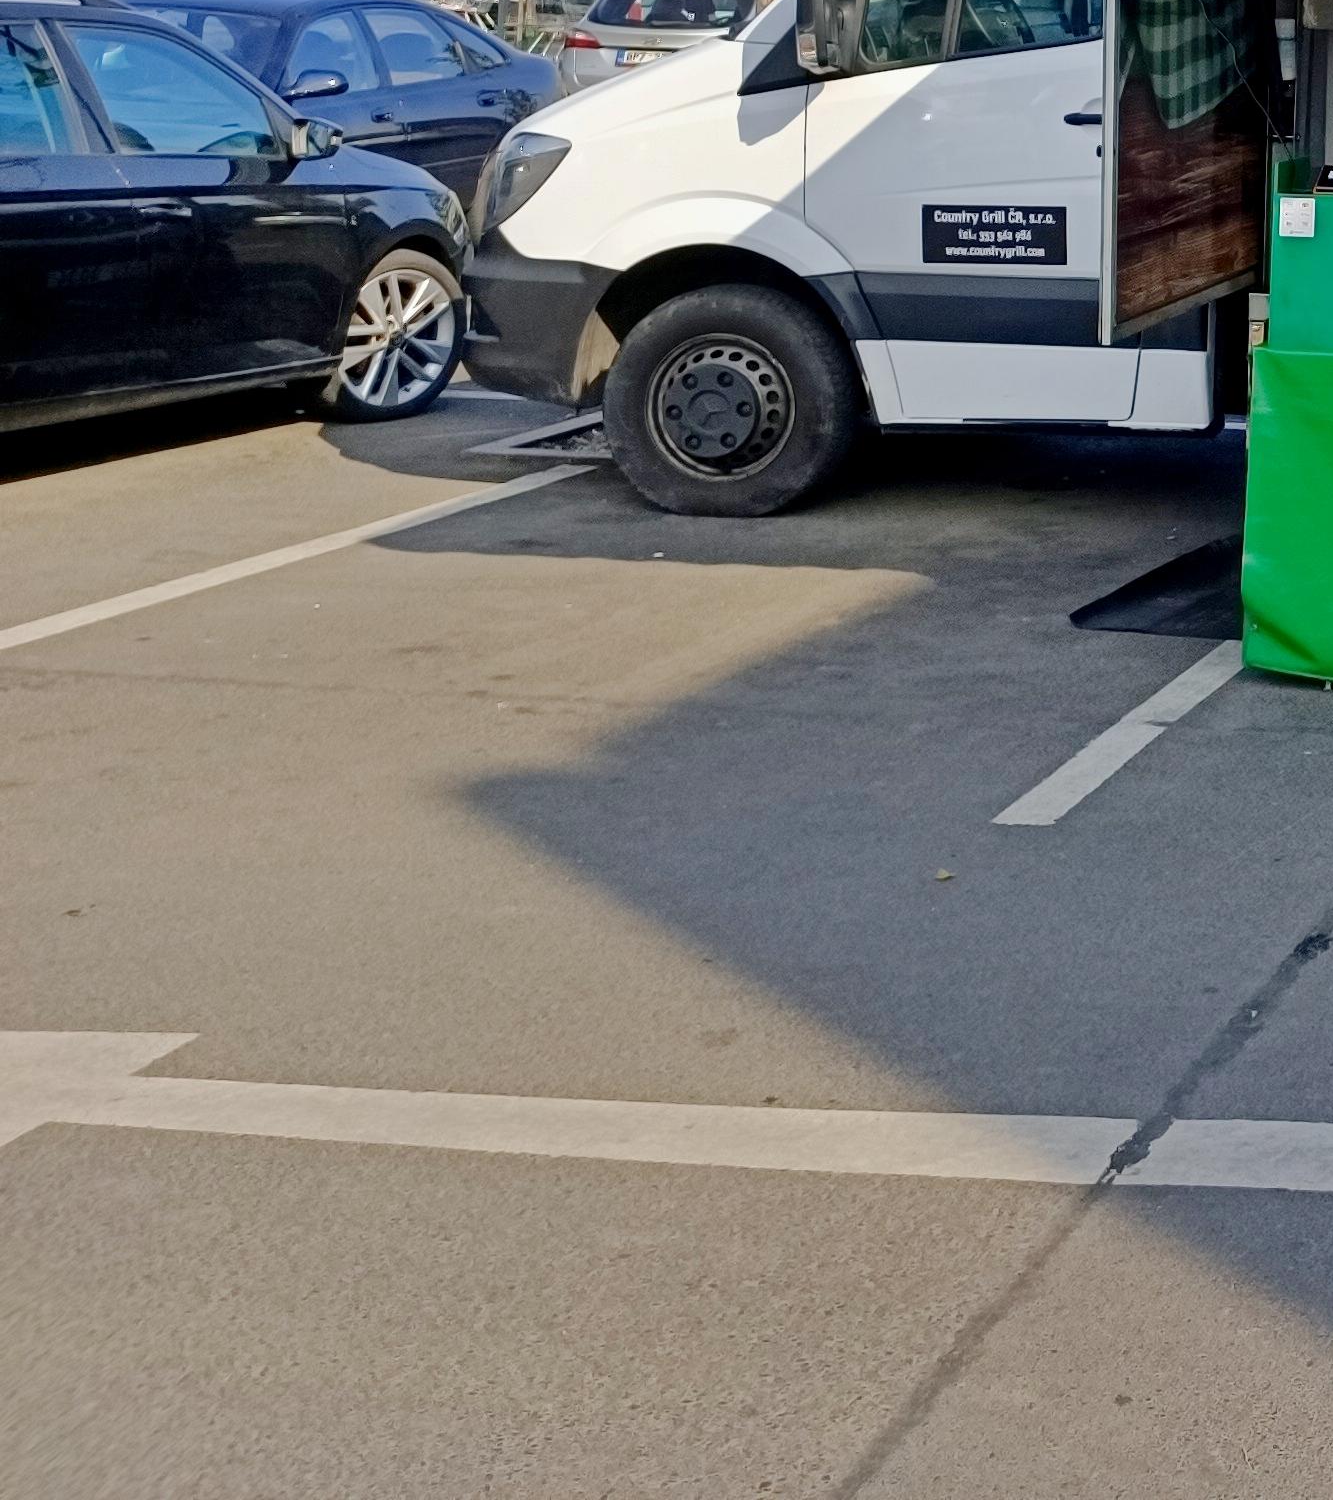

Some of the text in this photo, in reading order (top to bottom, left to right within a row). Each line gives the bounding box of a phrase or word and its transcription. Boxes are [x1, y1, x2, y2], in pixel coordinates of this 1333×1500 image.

[933, 208, 1057, 226] Country Grill ČR, s.r.o.
[945, 245, 1046, 259] www.countrygrill.com
